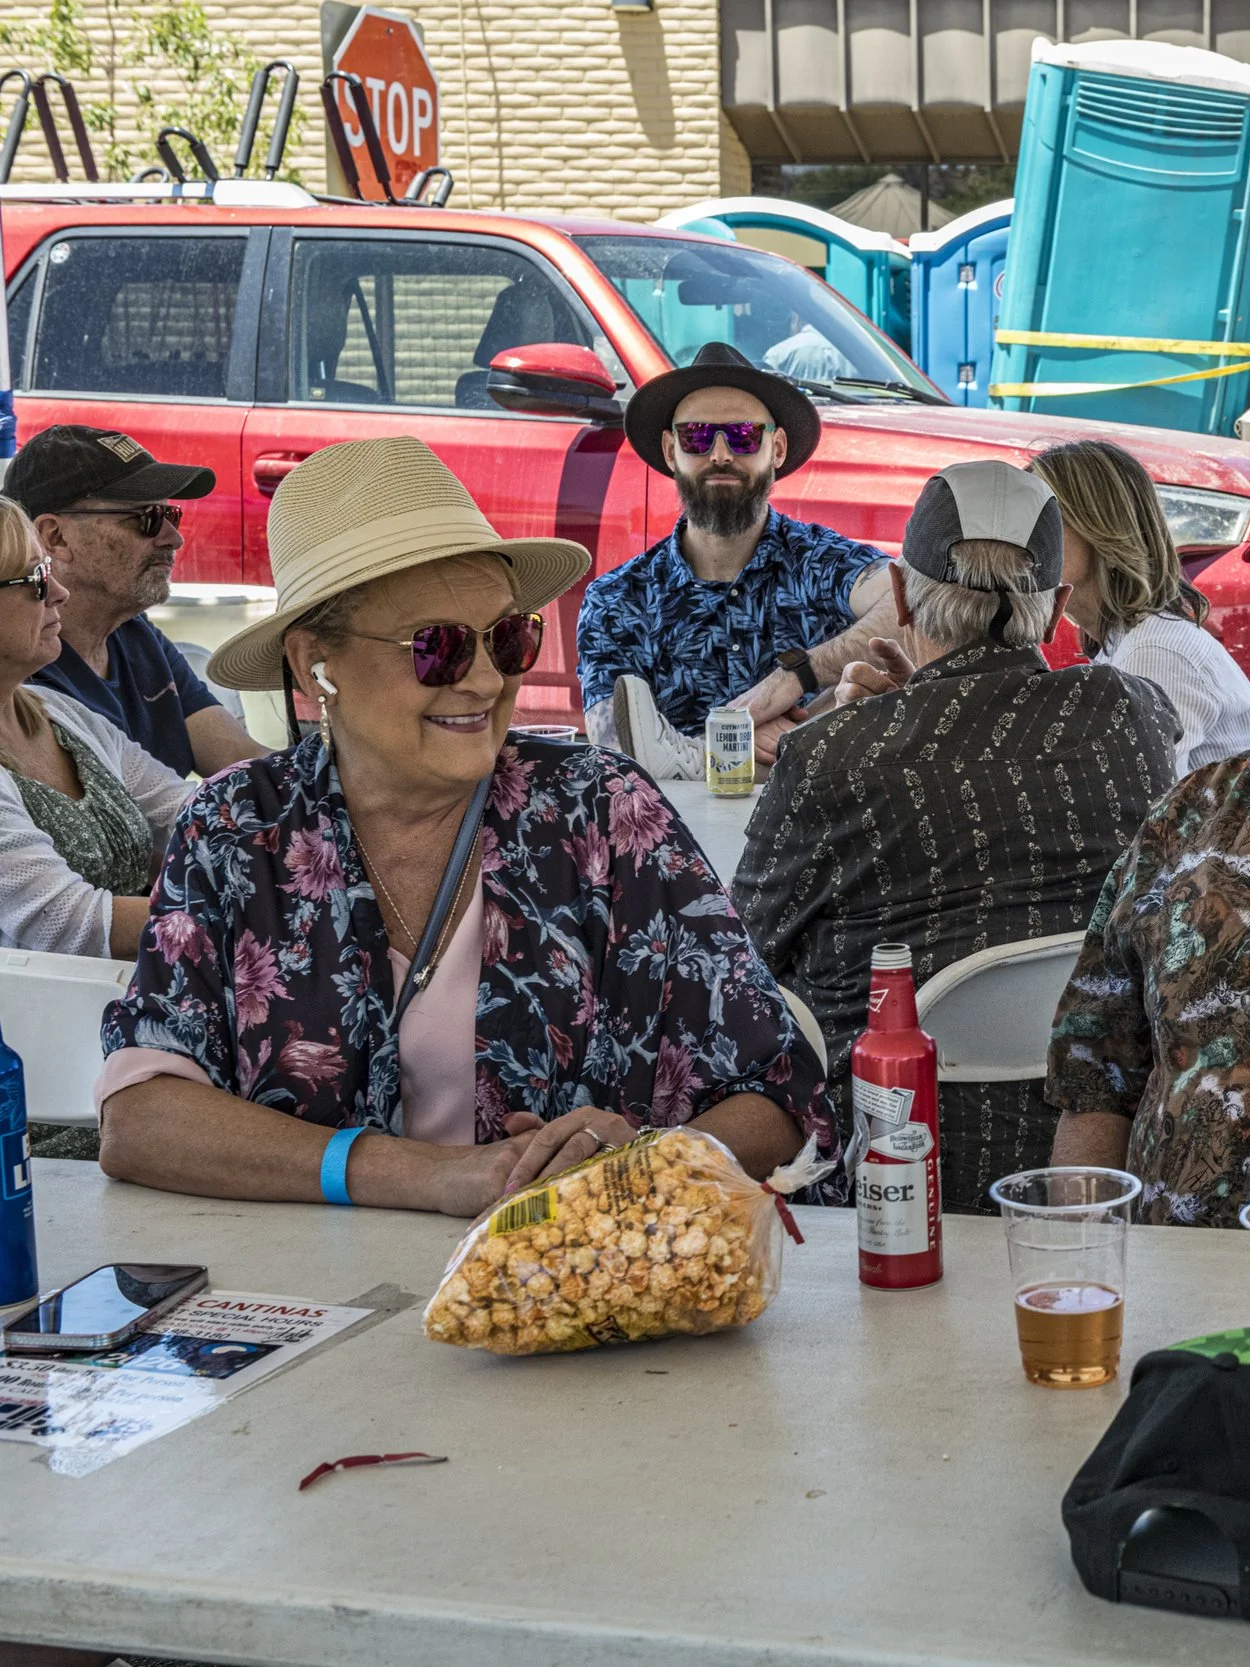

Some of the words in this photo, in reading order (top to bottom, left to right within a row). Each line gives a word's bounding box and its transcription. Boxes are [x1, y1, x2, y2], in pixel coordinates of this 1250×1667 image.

[343, 73, 434, 158] STOP
[715, 732, 738, 743] LEMON
[197, 1299, 329, 1319] CANTINAS
[188, 1310, 257, 1322] SPECIAL
[261, 1316, 325, 1328] HOURS
